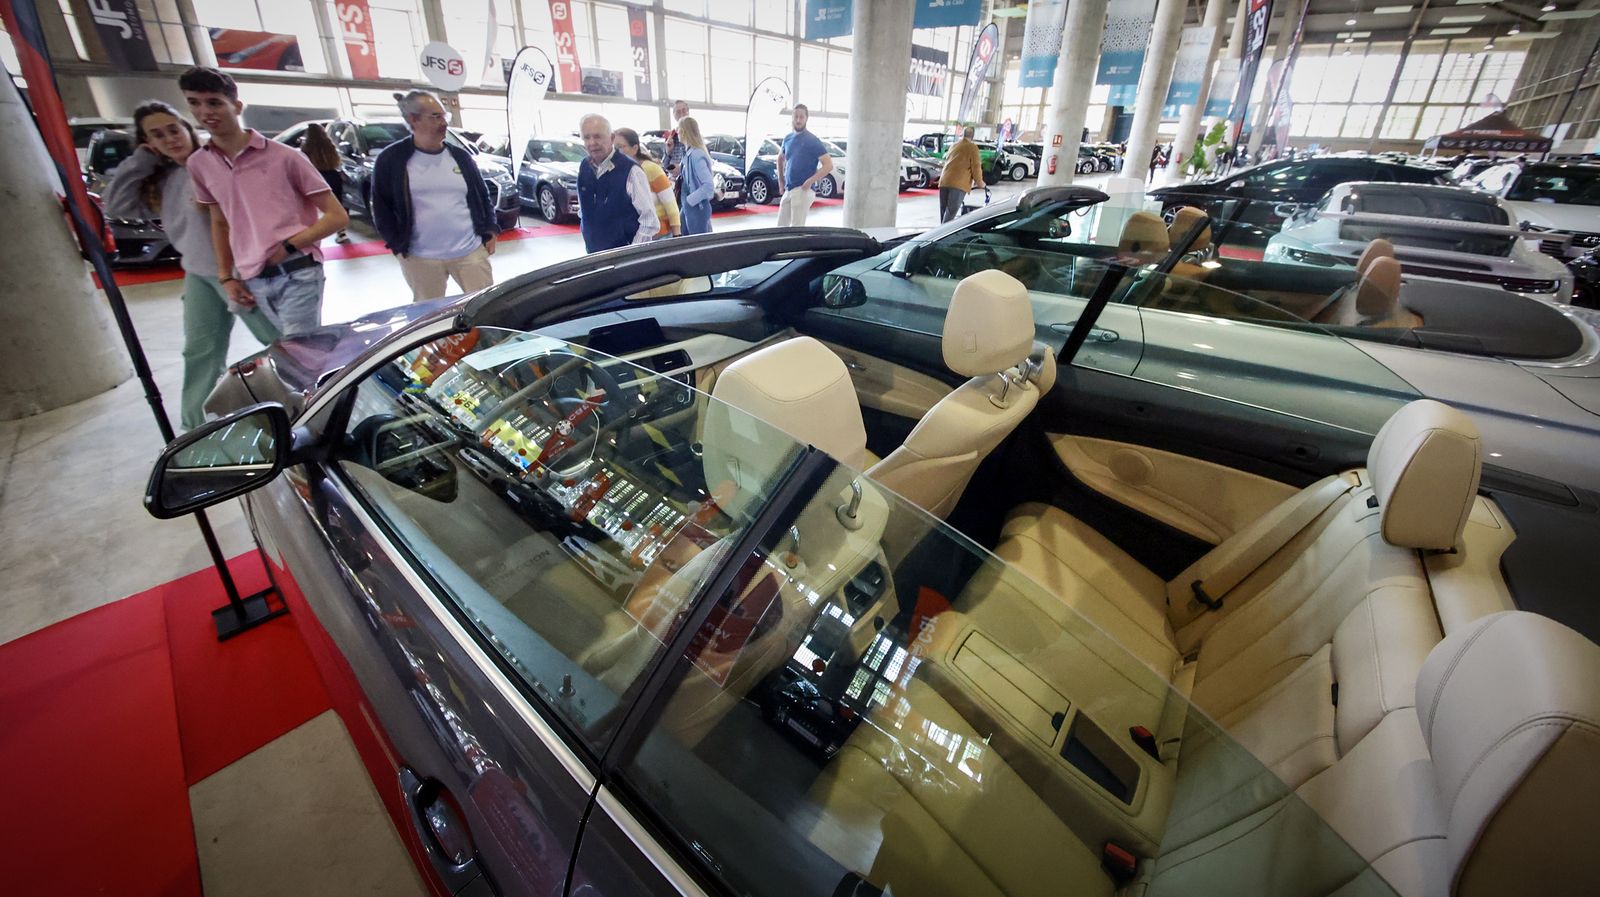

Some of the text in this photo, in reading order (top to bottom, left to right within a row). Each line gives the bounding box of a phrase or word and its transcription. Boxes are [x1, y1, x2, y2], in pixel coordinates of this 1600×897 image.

[337, 3, 370, 56] JFS
[421, 56, 446, 70] JFS
[520, 63, 534, 77] JFS
[555, 31, 576, 73] JFS
[631, 46, 647, 84] JFS
